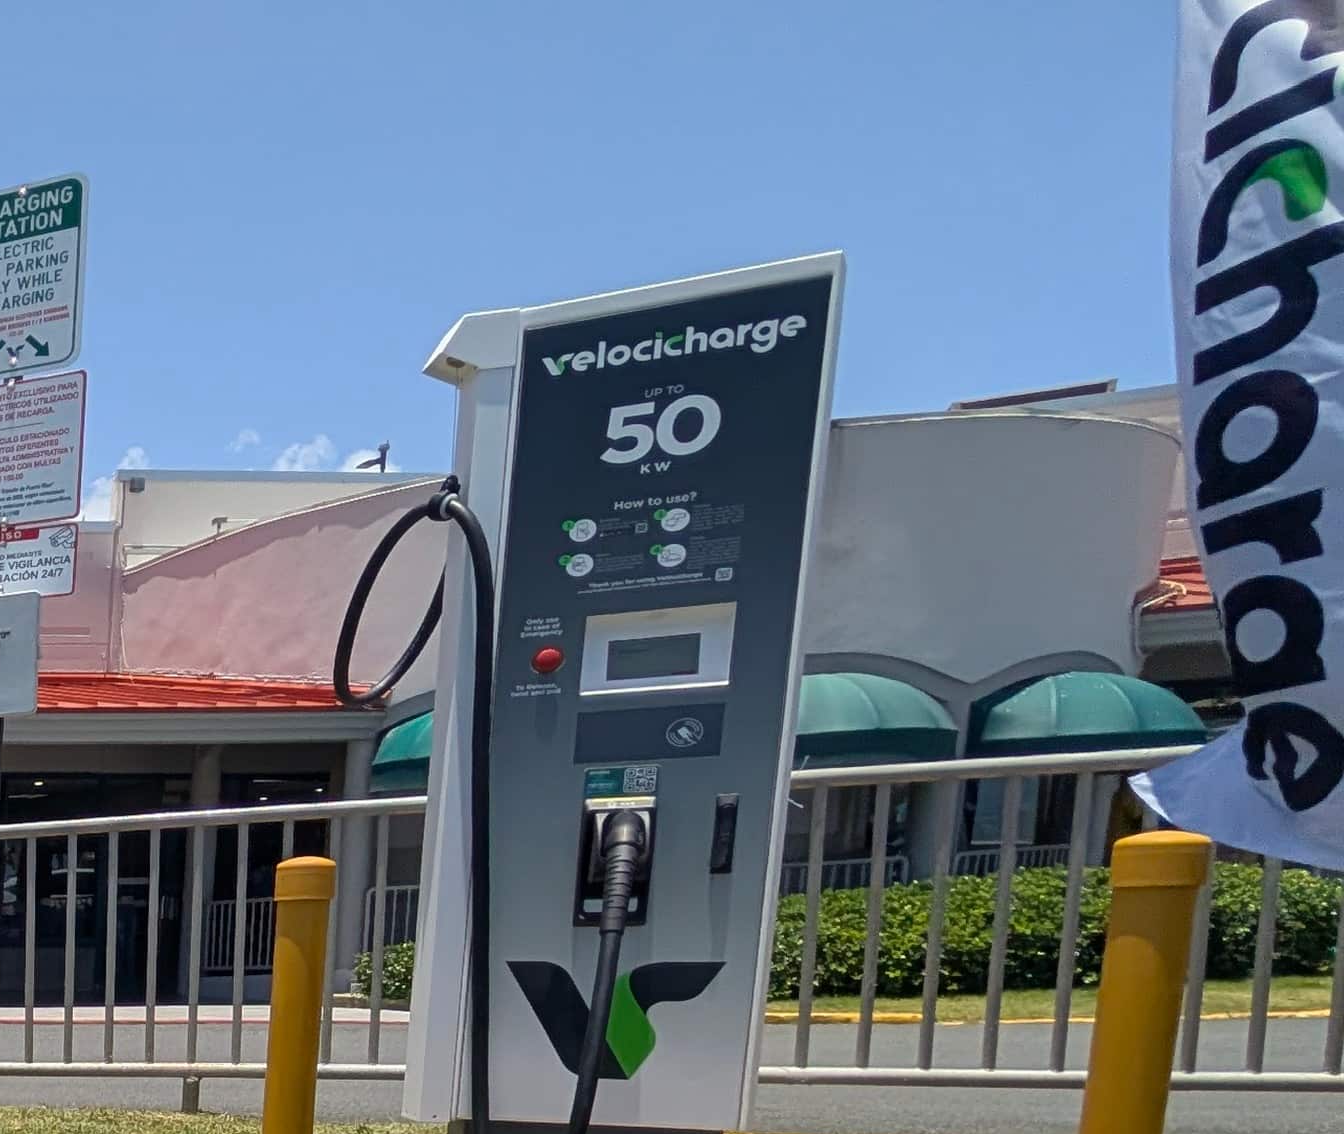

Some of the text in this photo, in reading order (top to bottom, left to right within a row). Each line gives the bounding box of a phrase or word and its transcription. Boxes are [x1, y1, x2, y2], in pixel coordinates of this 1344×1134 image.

[6, 250, 69, 276] PARKING
[17, 268, 63, 291] WHILE
[542, 314, 807, 376] velocicharge
[13, 383, 55, 400] EXCLUSIVO
[57, 382, 78, 393] PARA
[34, 392, 79, 406] UTILIZANDO
[644, 384, 684, 398] UP TO
[5, 412, 15, 421] DE
[600, 394, 721, 464] 50
[614, 491, 698, 511] How to use?
[8, 555, 71, 570] VIGILANCIA
[41, 568, 64, 579] 24/7
